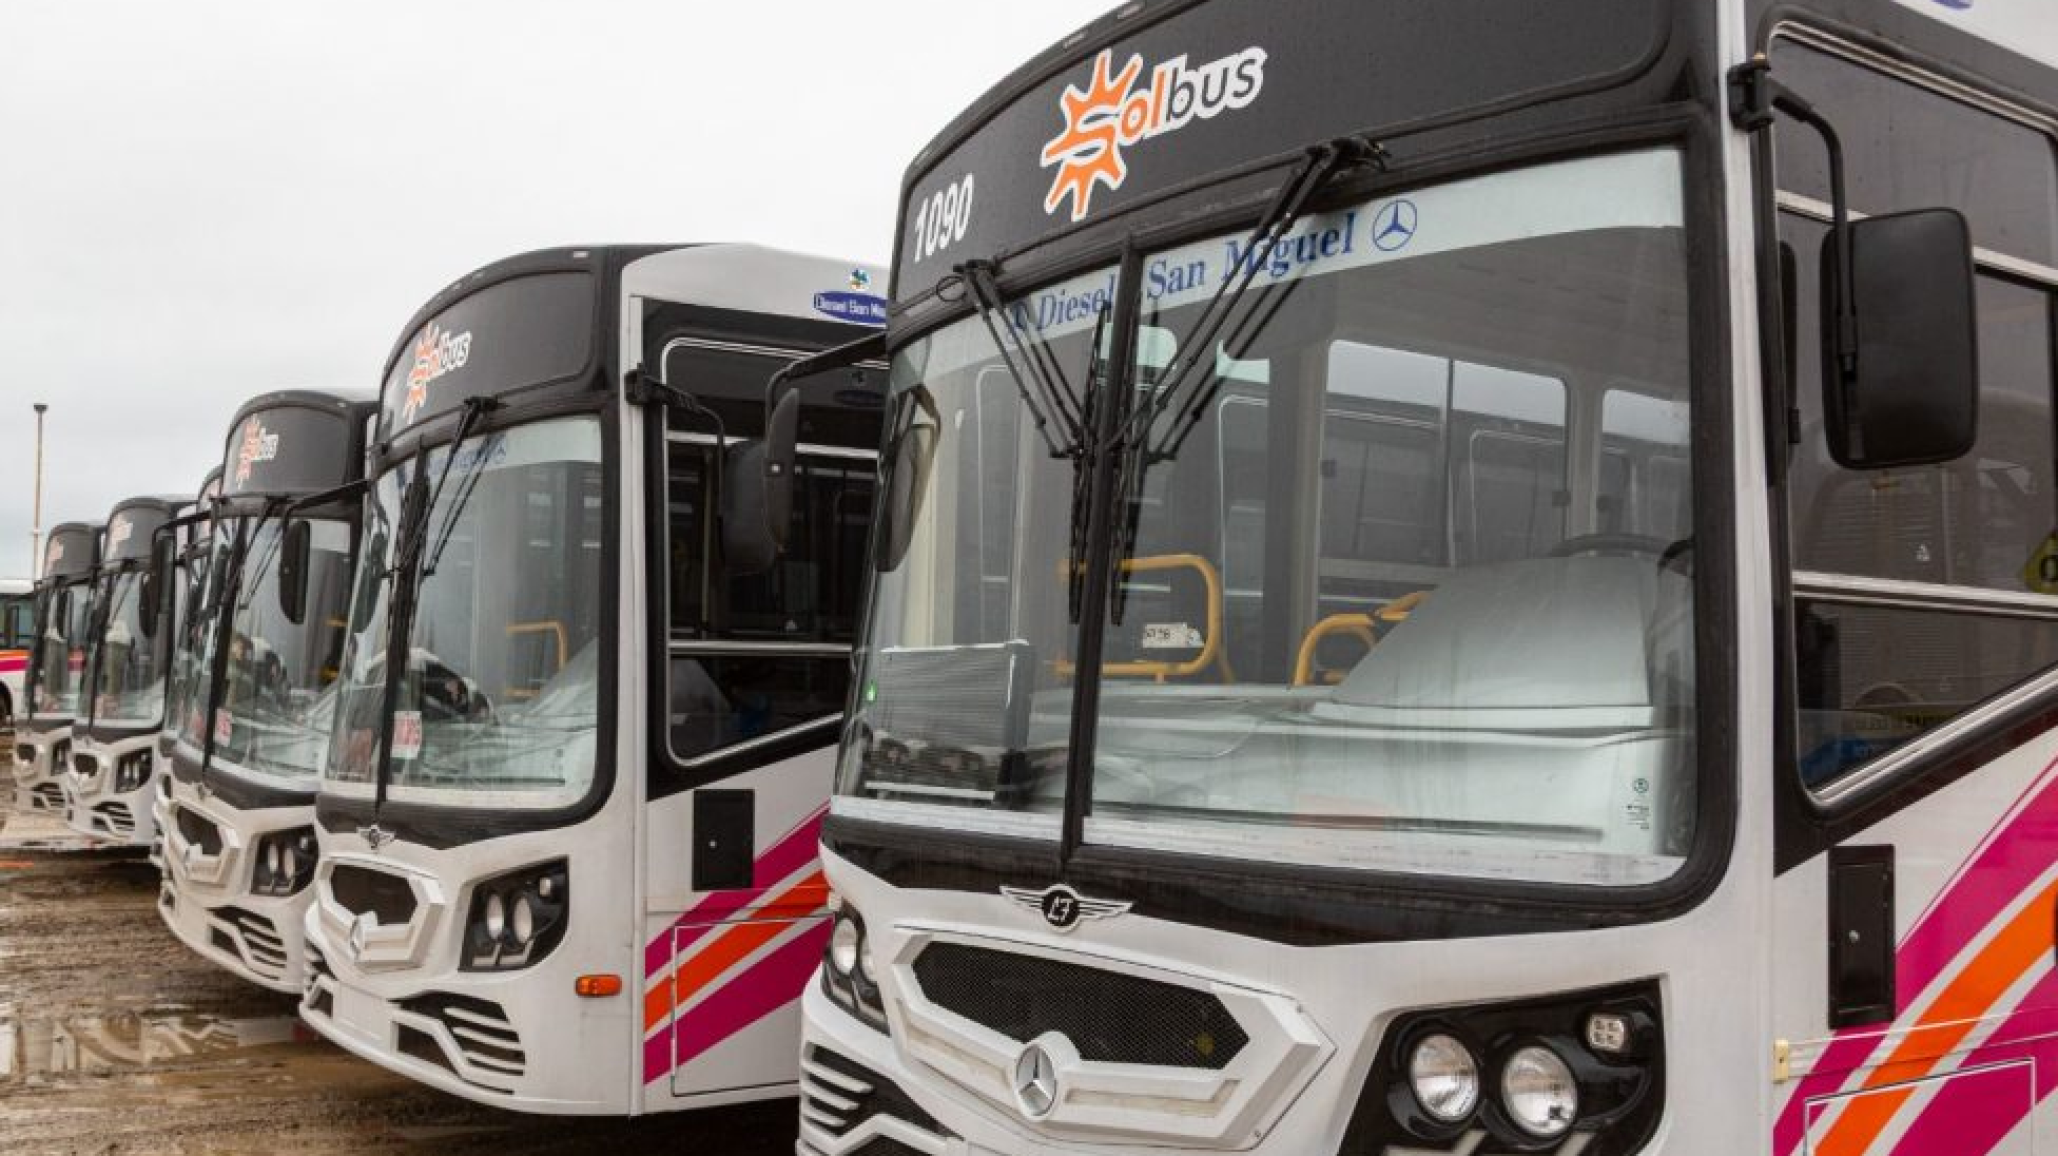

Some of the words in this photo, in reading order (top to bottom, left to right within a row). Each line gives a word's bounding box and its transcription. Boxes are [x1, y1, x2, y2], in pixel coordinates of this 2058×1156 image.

[1040, 47, 1268, 222] Solbus
[914, 172, 974, 264] 1090
[1035, 273, 1117, 332] Diesel
[1147, 259, 1206, 300] San
